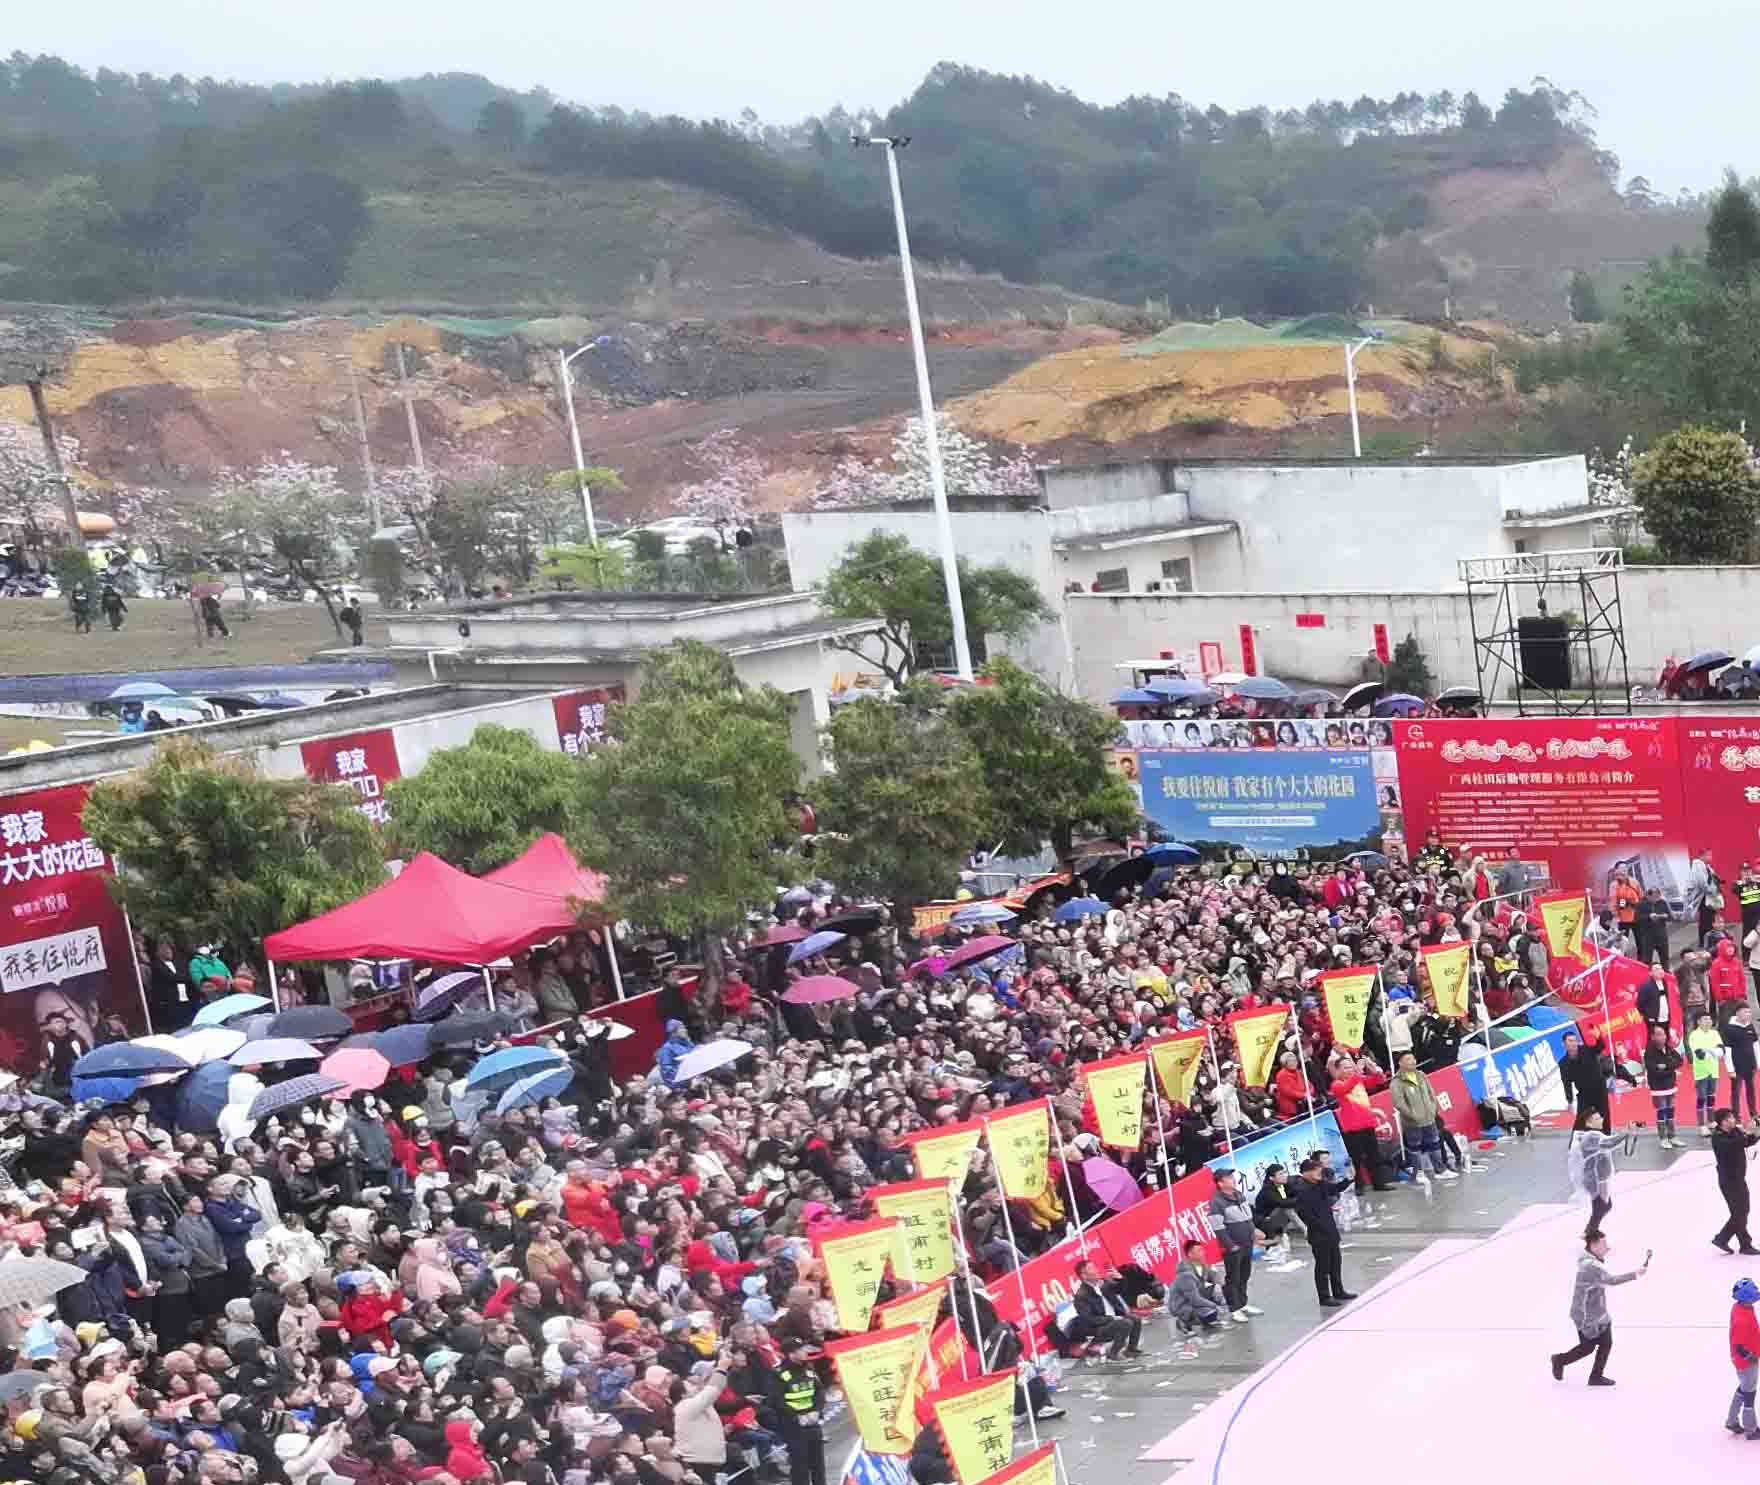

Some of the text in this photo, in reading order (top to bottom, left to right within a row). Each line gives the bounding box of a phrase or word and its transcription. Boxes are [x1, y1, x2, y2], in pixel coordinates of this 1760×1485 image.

[335, 747, 368, 776] 我家
[1, 811, 48, 847] 我家
[4, 935, 100, 980] 我要住悦府
